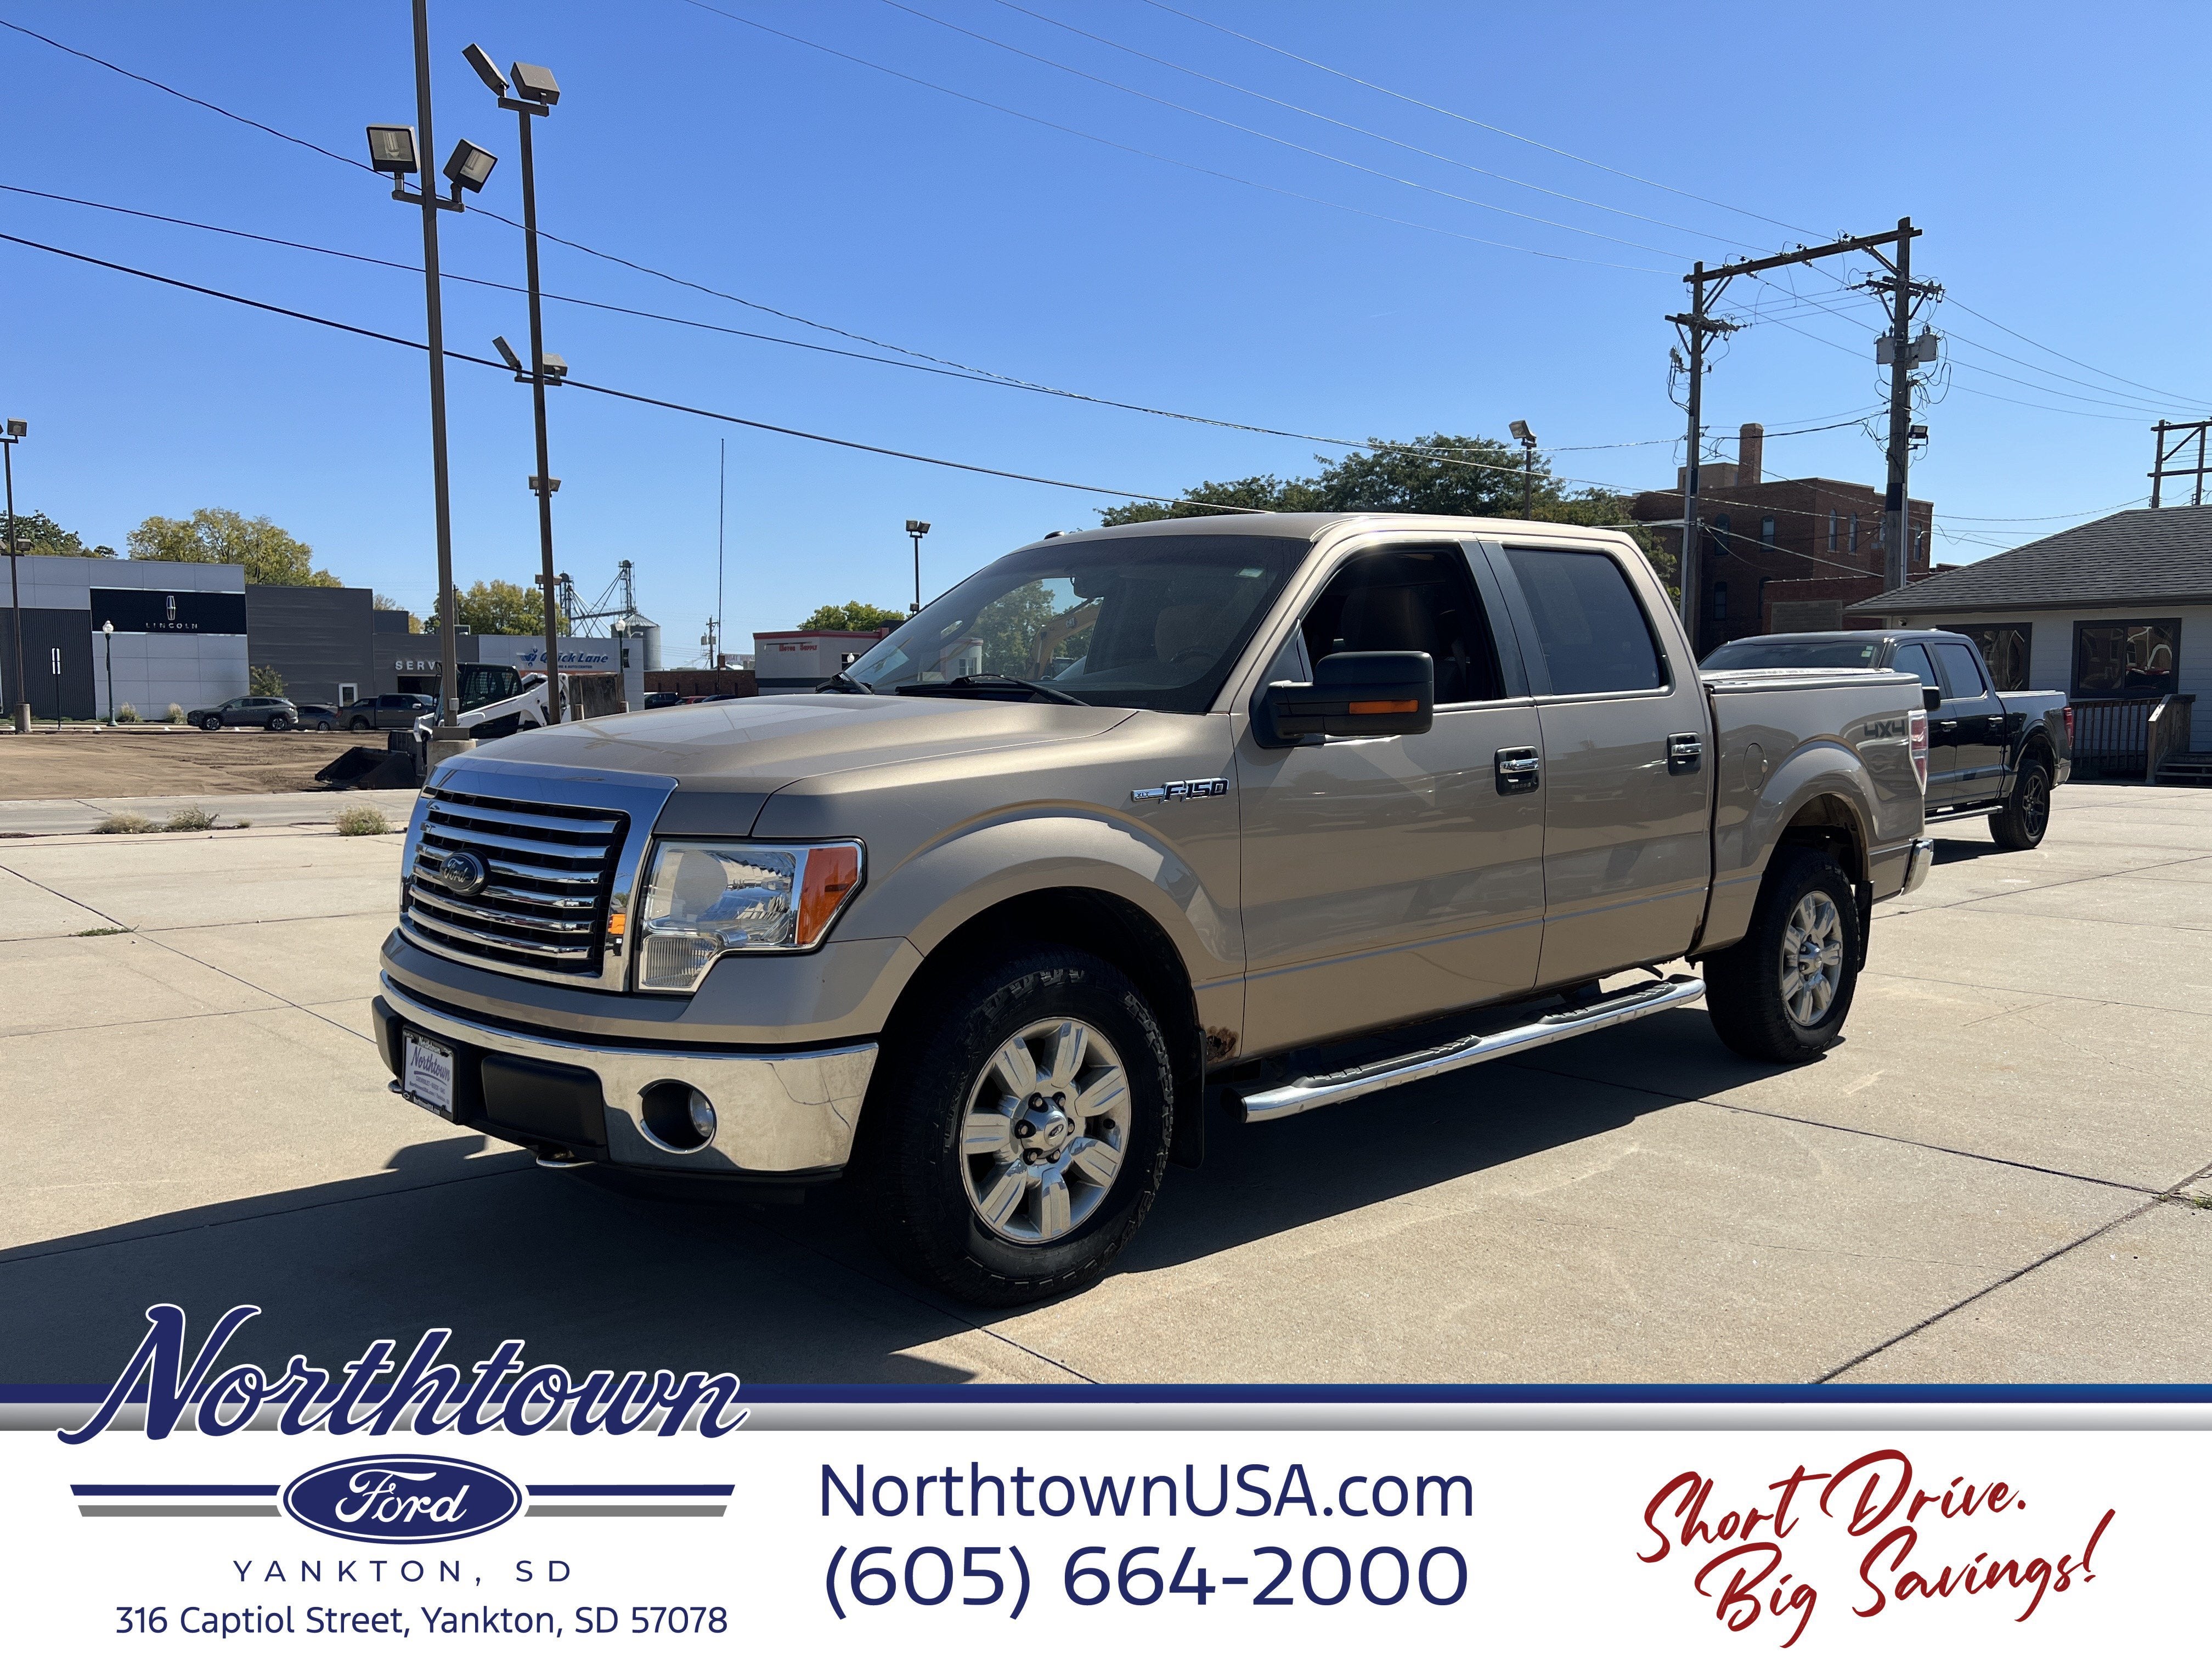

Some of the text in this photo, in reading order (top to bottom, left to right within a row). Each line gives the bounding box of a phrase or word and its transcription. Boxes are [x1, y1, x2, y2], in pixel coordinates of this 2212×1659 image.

[395, 661, 436, 670] SERV
[540, 652, 608, 663] Qick Lane
[443, 857, 469, 883] Ford
[410, 1046, 450, 1082] Northtown
